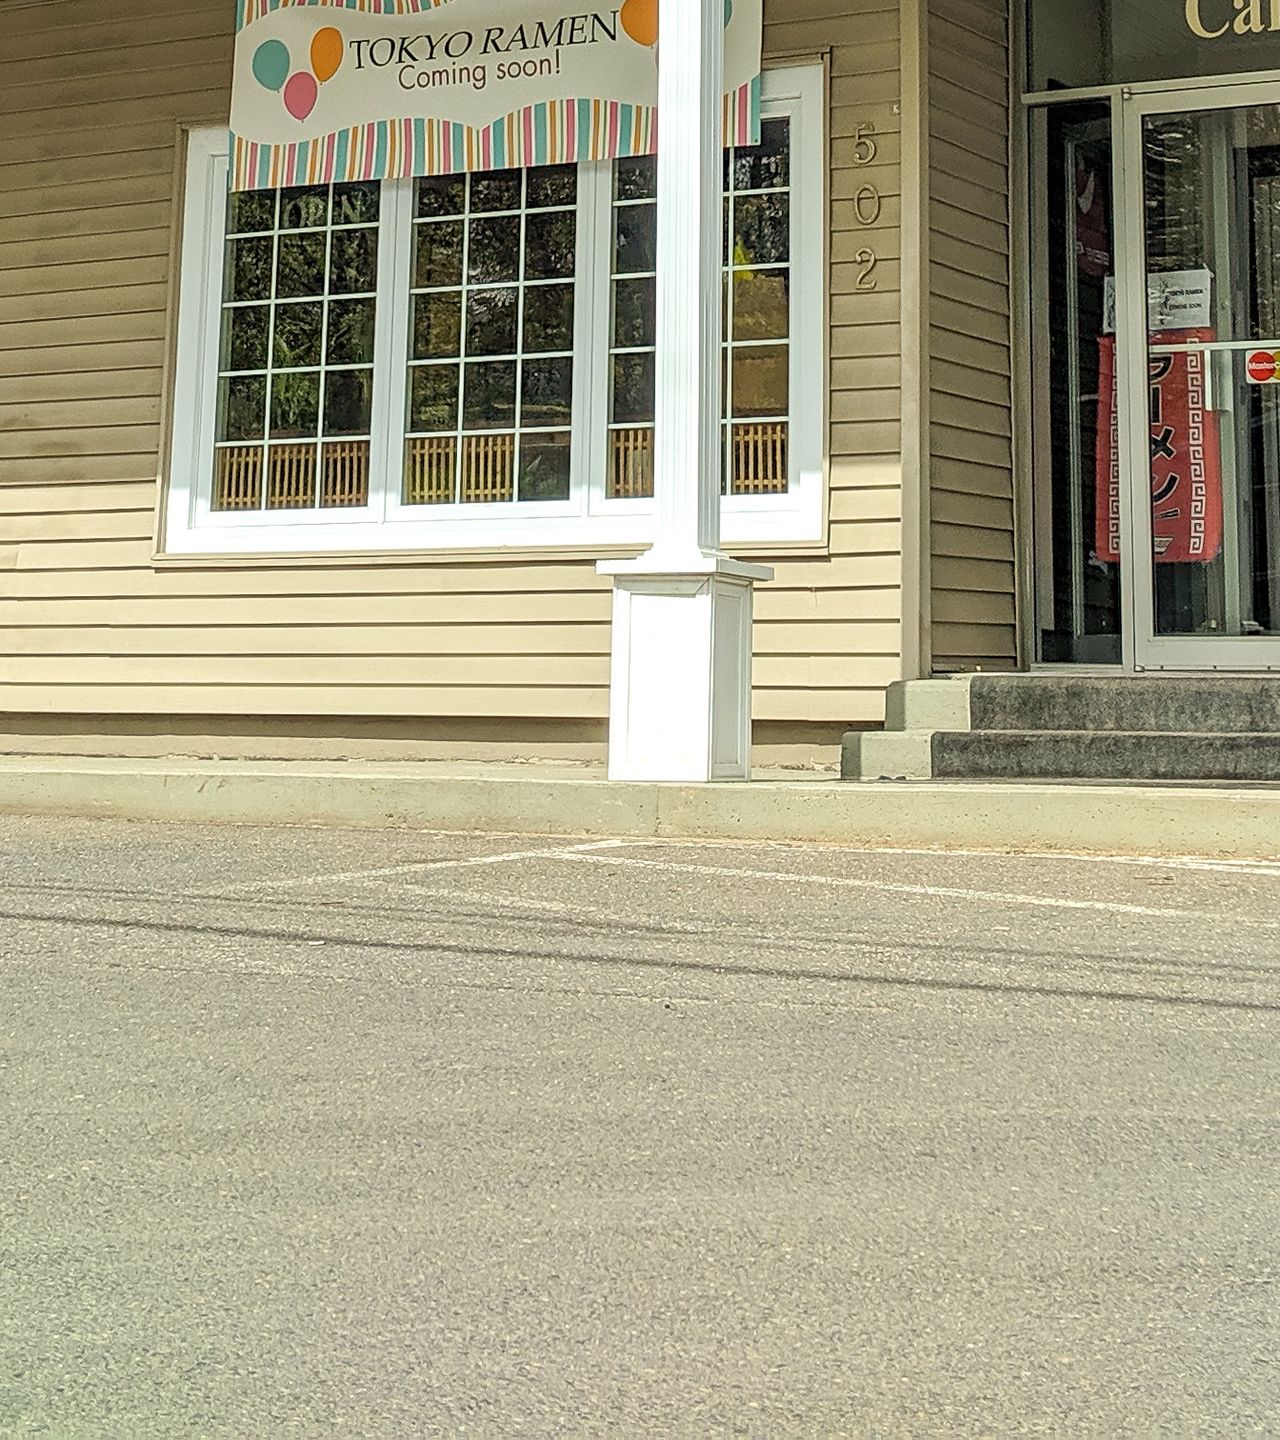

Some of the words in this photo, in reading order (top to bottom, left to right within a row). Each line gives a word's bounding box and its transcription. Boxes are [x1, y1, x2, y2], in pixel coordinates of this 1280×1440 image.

[349, 31, 473, 70] TOKYO
[479, 10, 620, 55] RAMEN
[398, 61, 487, 90] Coming
[496, 48, 561, 80] soon!
